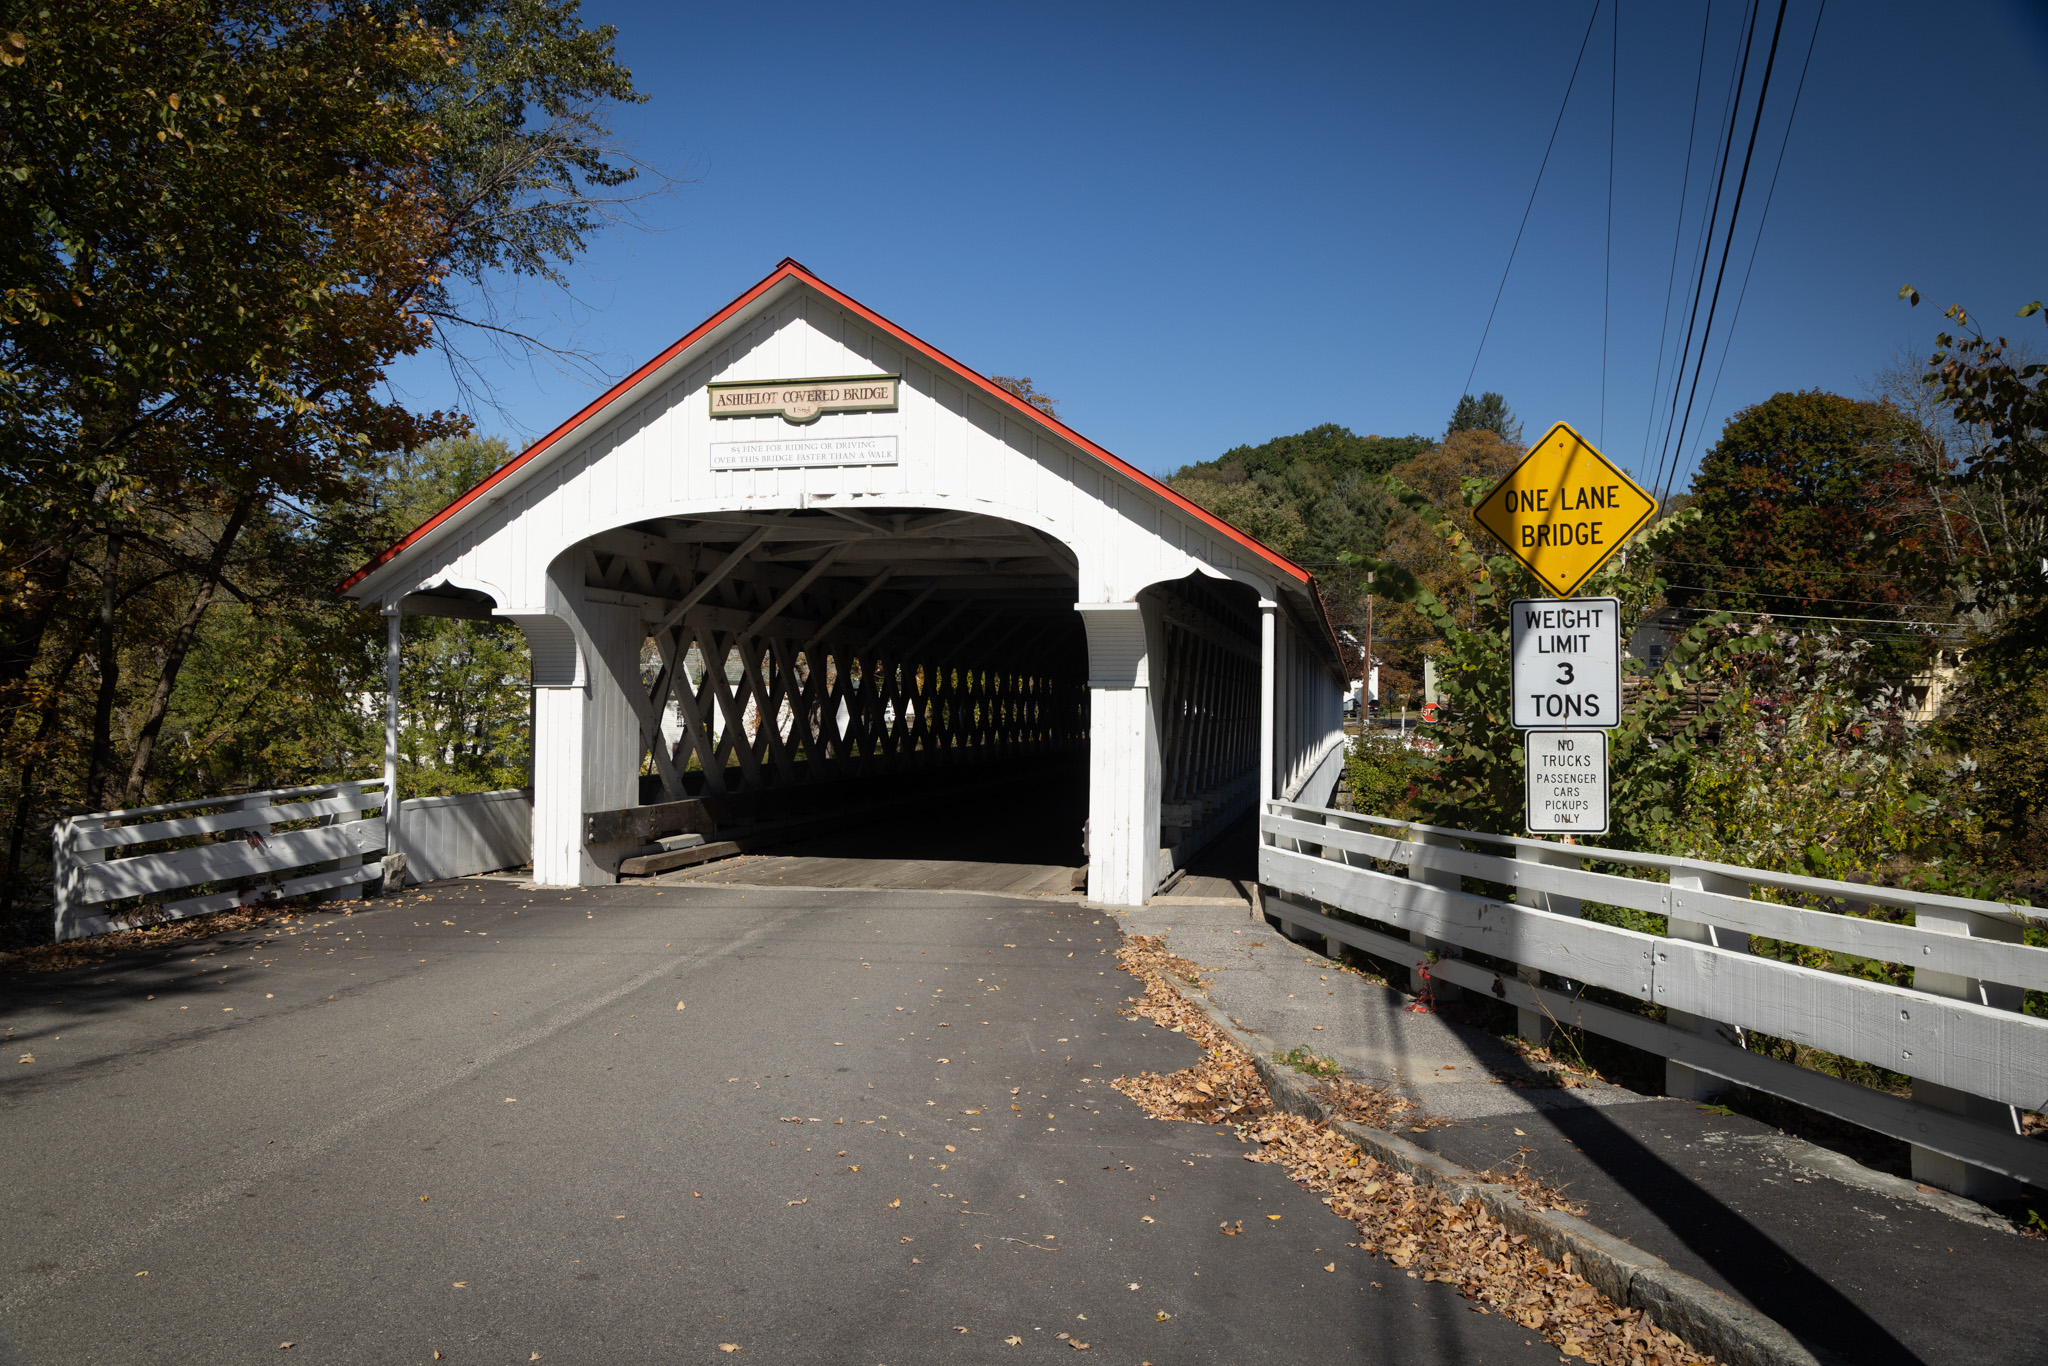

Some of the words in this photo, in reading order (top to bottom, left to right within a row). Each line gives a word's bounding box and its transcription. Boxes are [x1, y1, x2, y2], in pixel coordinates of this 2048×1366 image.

[716, 391, 778, 407] ASHUELOT
[782, 389, 840, 404] COVERED
[842, 386, 889, 401] BRIDGE
[743, 445, 763, 453] FINE
[766, 444, 782, 452] FOR
[785, 442, 818, 451] RIDING
[820, 442, 833, 450] OR
[836, 440, 875, 449] DRIVING
[714, 456, 737, 464] OVER
[740, 455, 760, 463] THIS
[761, 454, 794, 462] BRIDGE
[797, 453, 827, 461] FASTER
[829, 451, 855, 460] THAN
[858, 451, 865, 459] A
[868, 450, 893, 458] WALK
[1504, 488, 1549, 513] ONE
[1561, 485, 1620, 510] LANE
[1522, 521, 1603, 547] BRIDGE
[1525, 609, 1603, 629] WEIGHT
[1538, 634, 1590, 654] LIMIT
[1555, 662, 1575, 685] 3
[1531, 693, 1600, 717] TONS
[1557, 739, 1574, 752] NO
[1542, 754, 1591, 767] TRUCKS
[1536, 773, 1597, 784] PASSENGER
[1553, 787, 1580, 797] CARS
[1545, 800, 1589, 810] PICKUPS
[1554, 813, 1580, 824] ONLY
